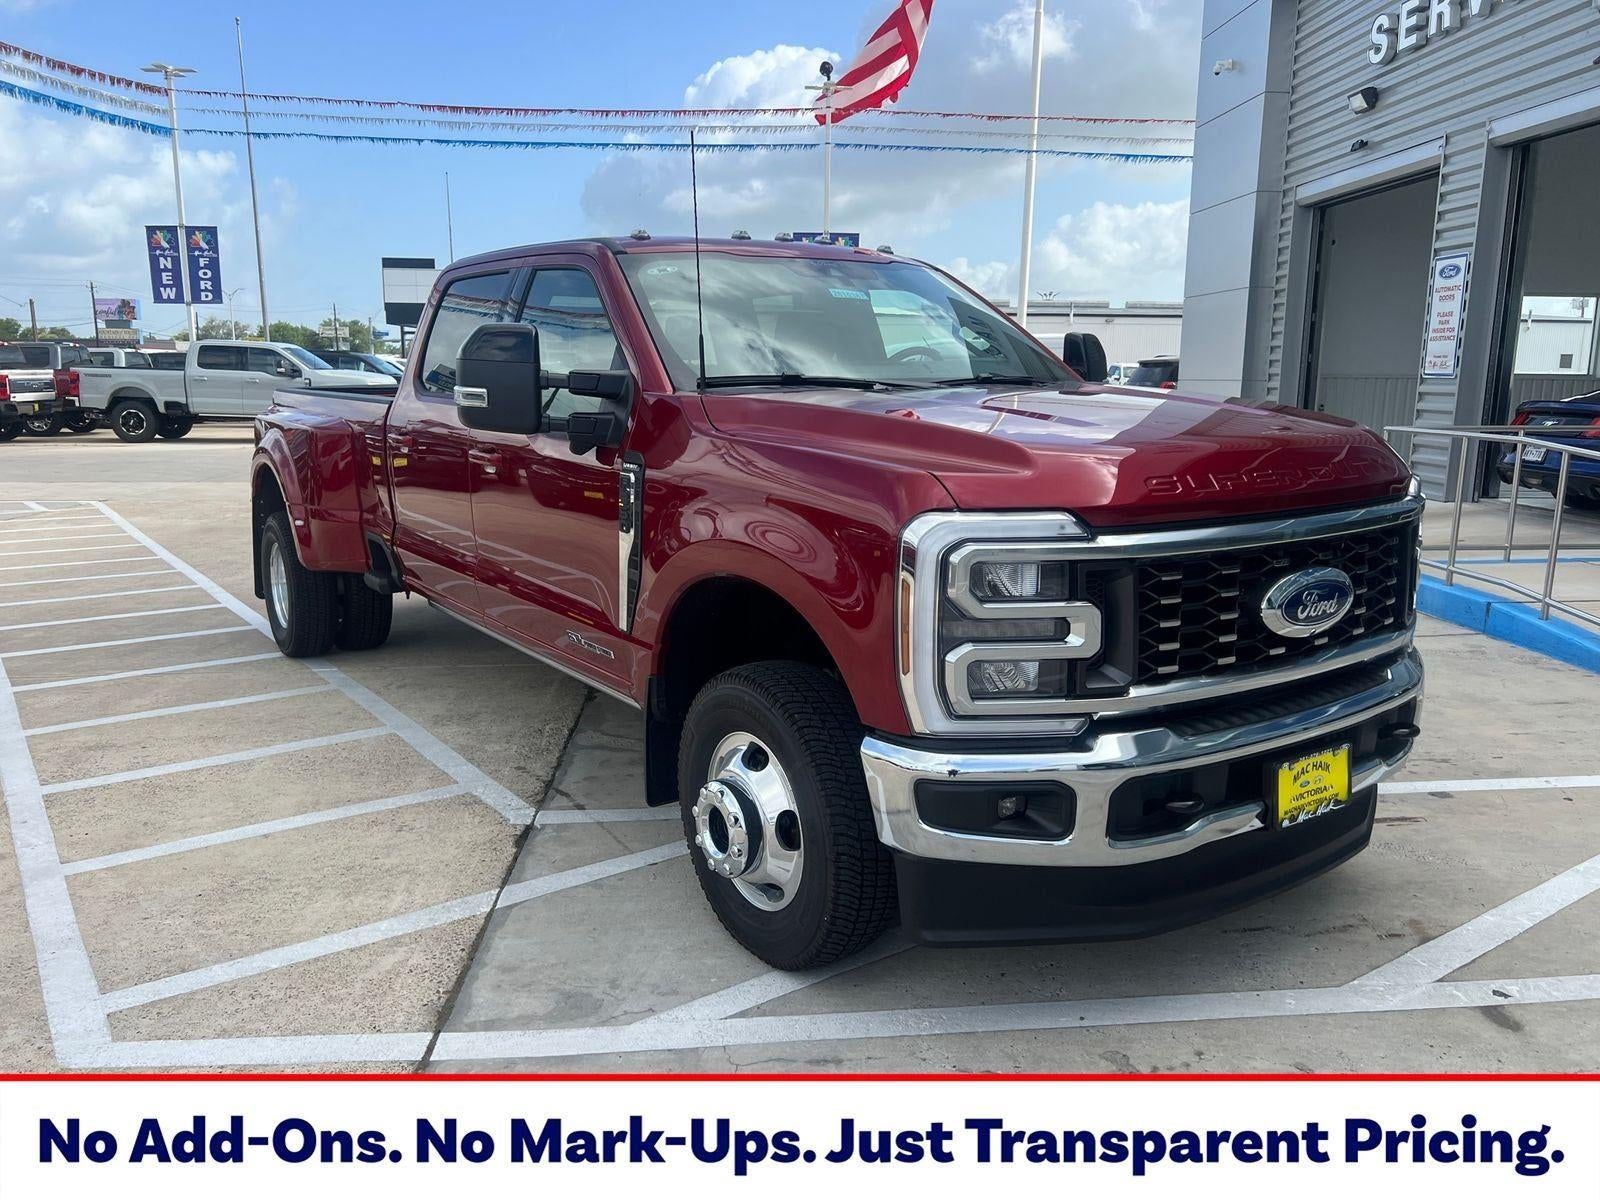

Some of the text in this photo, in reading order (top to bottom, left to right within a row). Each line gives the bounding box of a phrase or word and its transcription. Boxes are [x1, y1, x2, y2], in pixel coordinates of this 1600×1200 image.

[158, 256, 176, 300] NEW
[198, 257, 214, 301] FORD
[1434, 285, 1462, 293] AUTOMATIC
[1439, 294, 1455, 302] DOORS
[1297, 587, 1339, 620] Ford
[1292, 763, 1311, 785] MAC
[1311, 760, 1331, 774] HAIK
